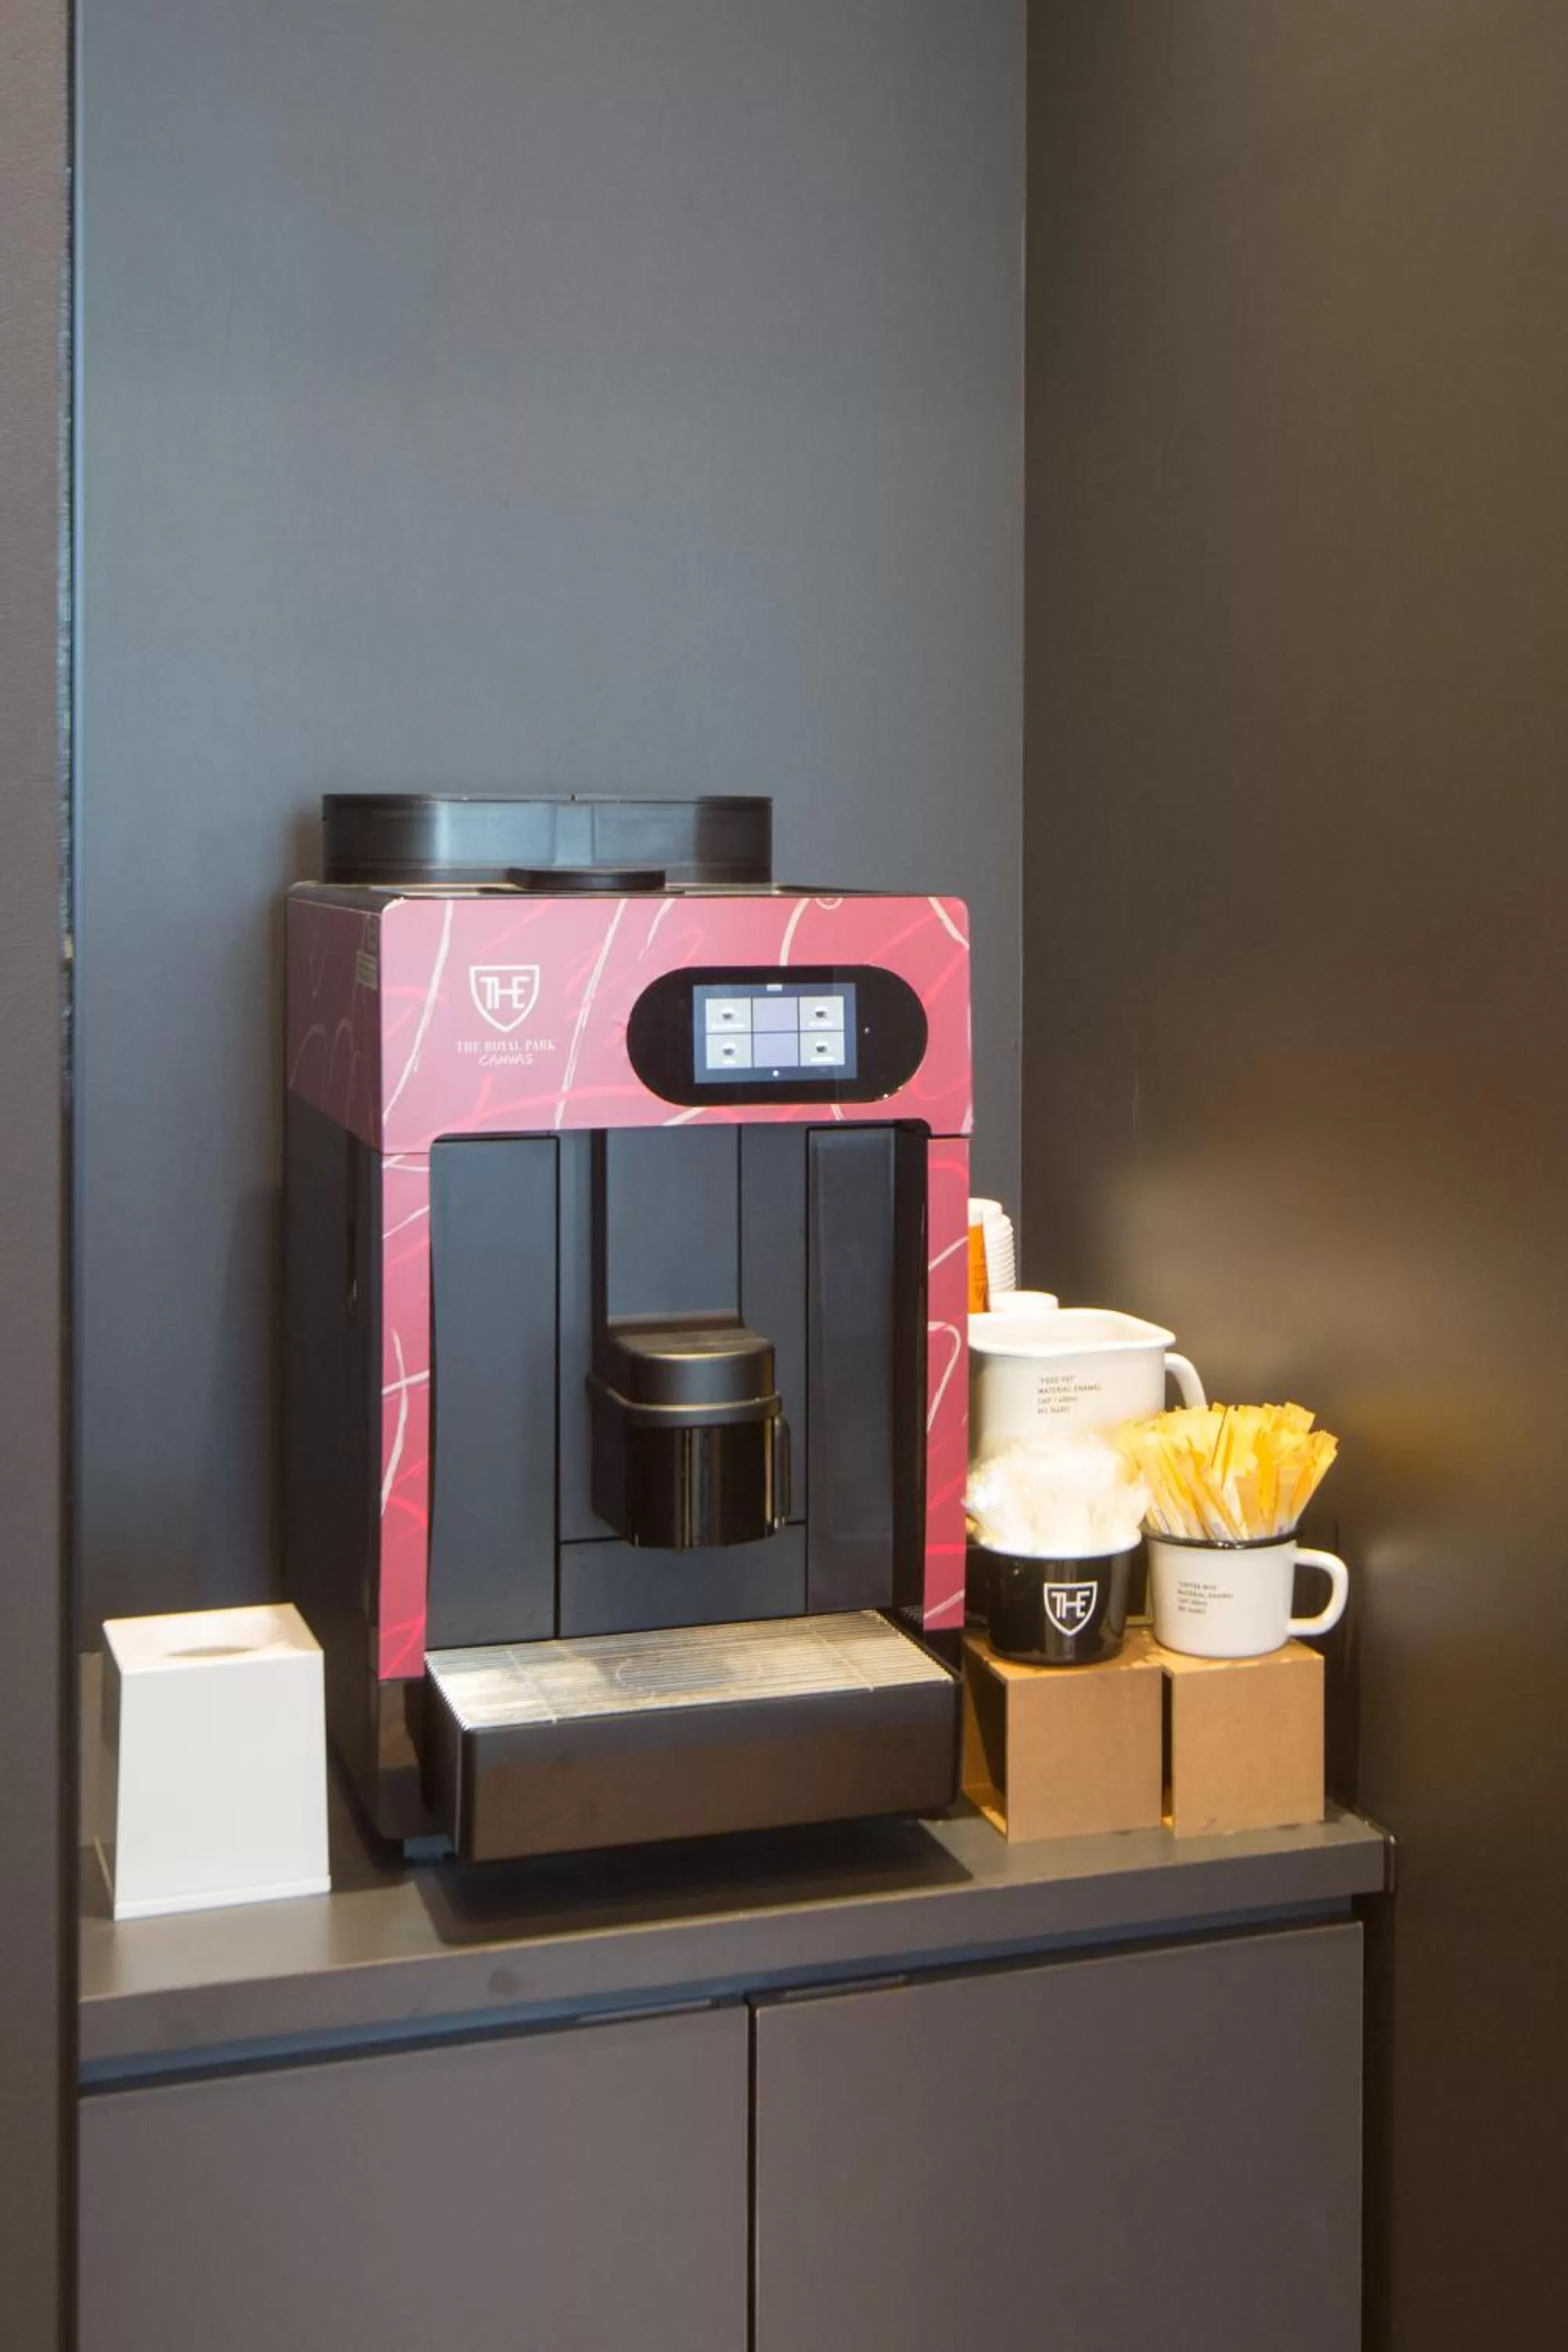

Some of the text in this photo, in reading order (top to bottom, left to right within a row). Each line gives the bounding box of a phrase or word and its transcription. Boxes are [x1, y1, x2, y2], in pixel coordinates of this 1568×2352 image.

[479, 976, 531, 1010] THE
[457, 1039, 556, 1054] THE ROYAL PARK
[1051, 1591, 1091, 1618] THE
